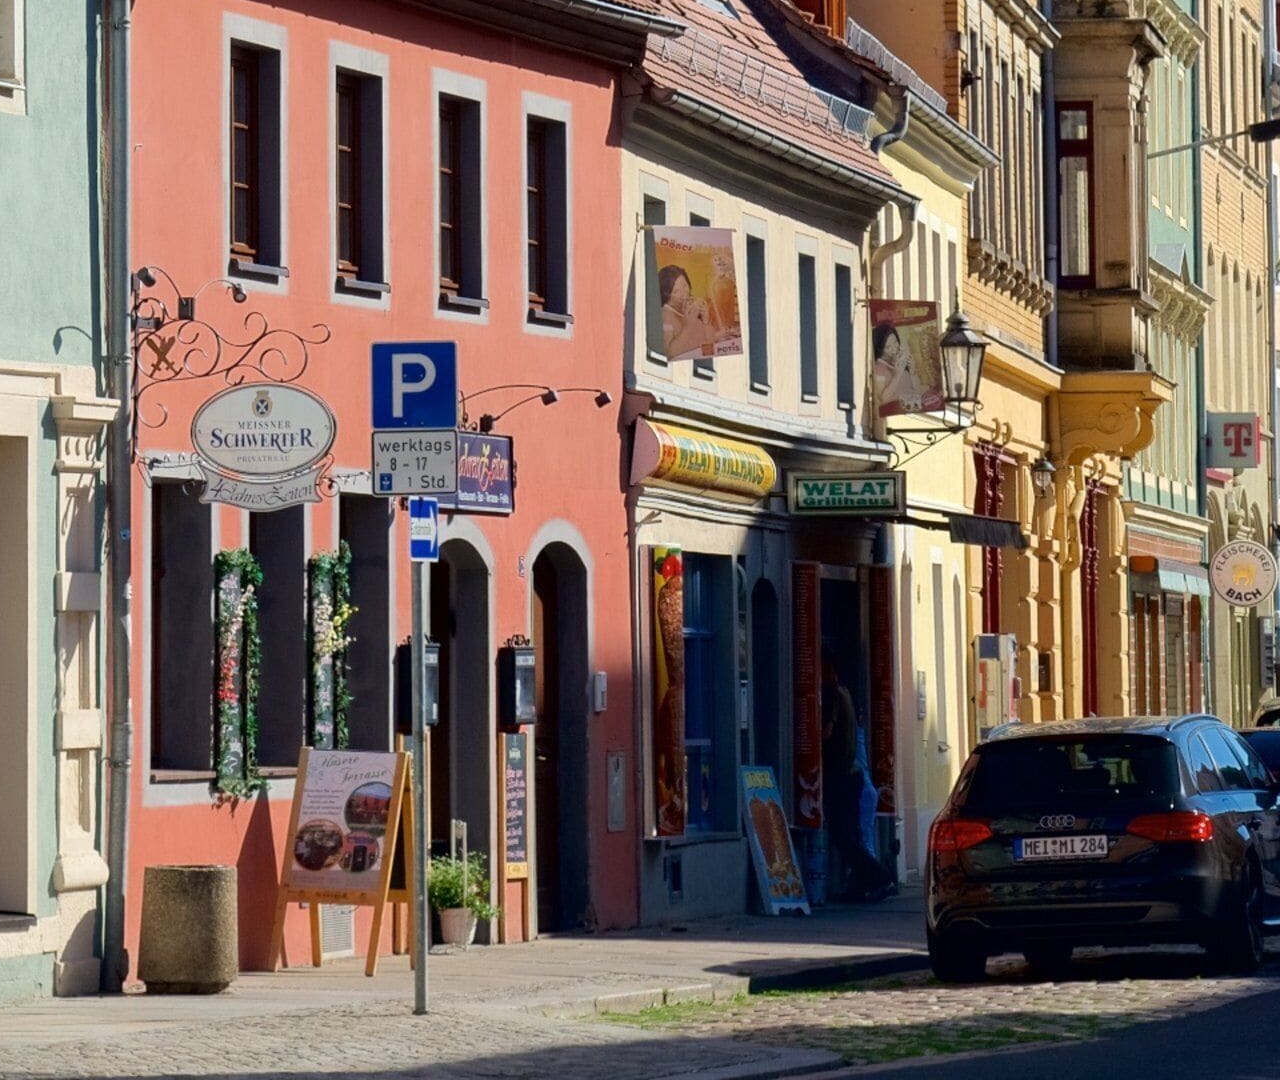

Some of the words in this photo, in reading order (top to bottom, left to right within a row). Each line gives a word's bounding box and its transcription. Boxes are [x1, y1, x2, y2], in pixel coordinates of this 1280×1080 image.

[660, 238, 693, 252] Döner
[392, 353, 436, 418] P
[238, 421, 291, 429] MEISSNER
[210, 428, 314, 453] SCHWERTER
[379, 439, 452, 454] werktags
[390, 458, 397, 471] 8
[416, 457, 428, 471] 17
[408, 477, 412, 487] 1
[802, 482, 889, 496] WELAT
[802, 497, 891, 506] Grillhaus
[1216, 544, 1270, 573] FLEISCHEREI
[1226, 587, 1262, 601] BACH
[322, 755, 360, 768] Unsere
[342, 768, 387, 782] Terrasse
[1024, 840, 1048, 855] MEI
[1060, 838, 1075, 853] MI
[1080, 837, 1104, 853] 284
